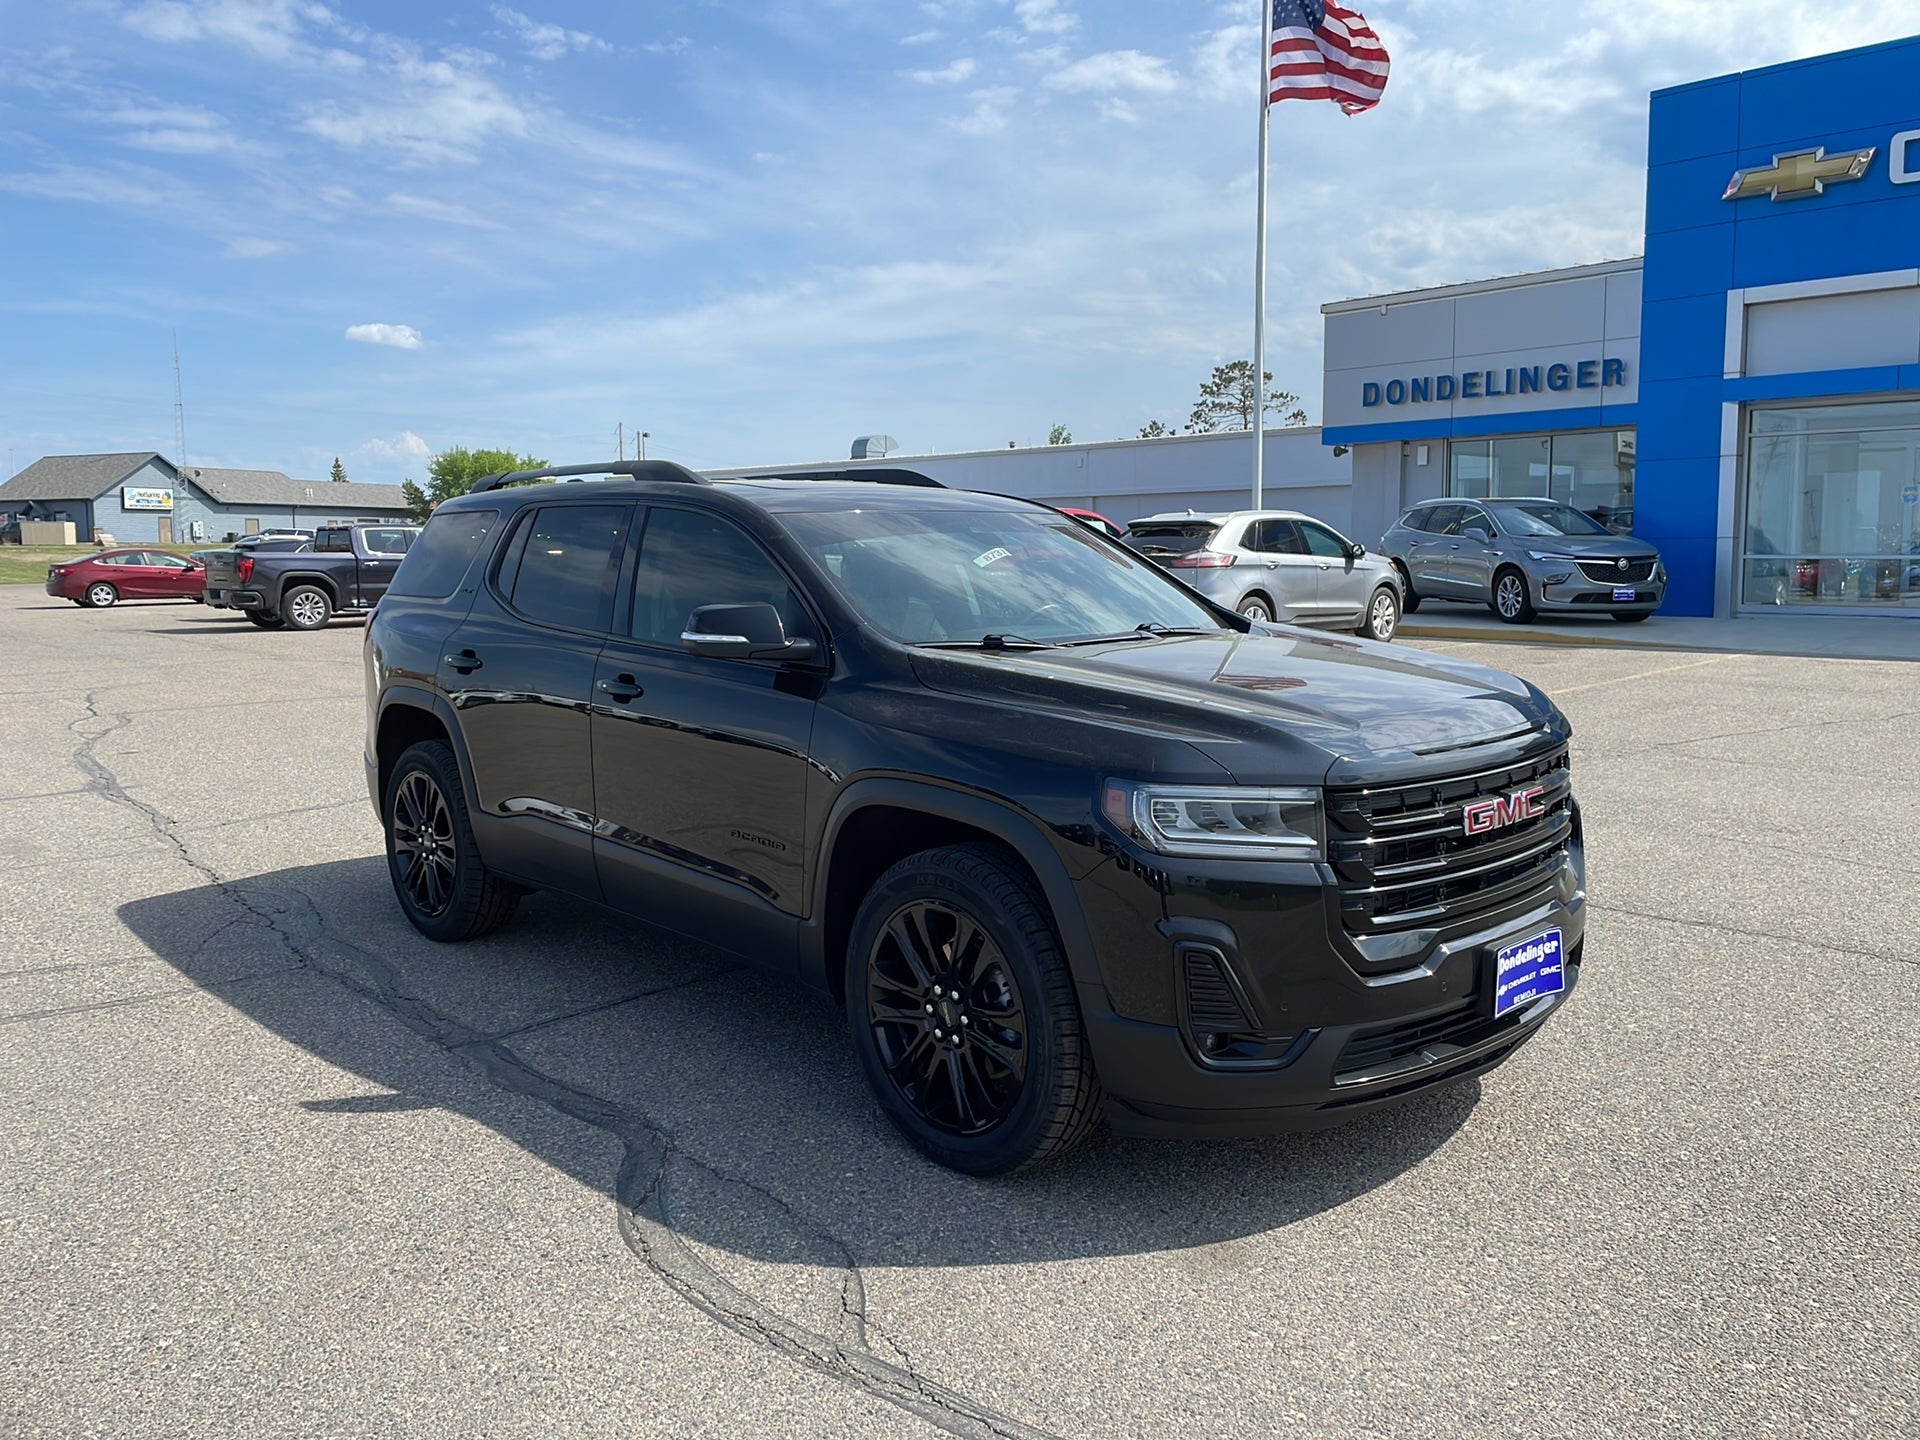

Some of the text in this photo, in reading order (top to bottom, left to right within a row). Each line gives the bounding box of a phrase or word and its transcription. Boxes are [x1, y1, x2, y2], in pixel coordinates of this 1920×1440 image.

[1362, 358, 1626, 407] DONDELINGER
[1463, 786, 1545, 836] GMC
[730, 830, 786, 851] ACADIA
[1499, 940, 1559, 976] Dondelinger
[1508, 964, 1561, 990] CHEVROLET GMC
[1513, 988, 1537, 1004] BEMIDJI
